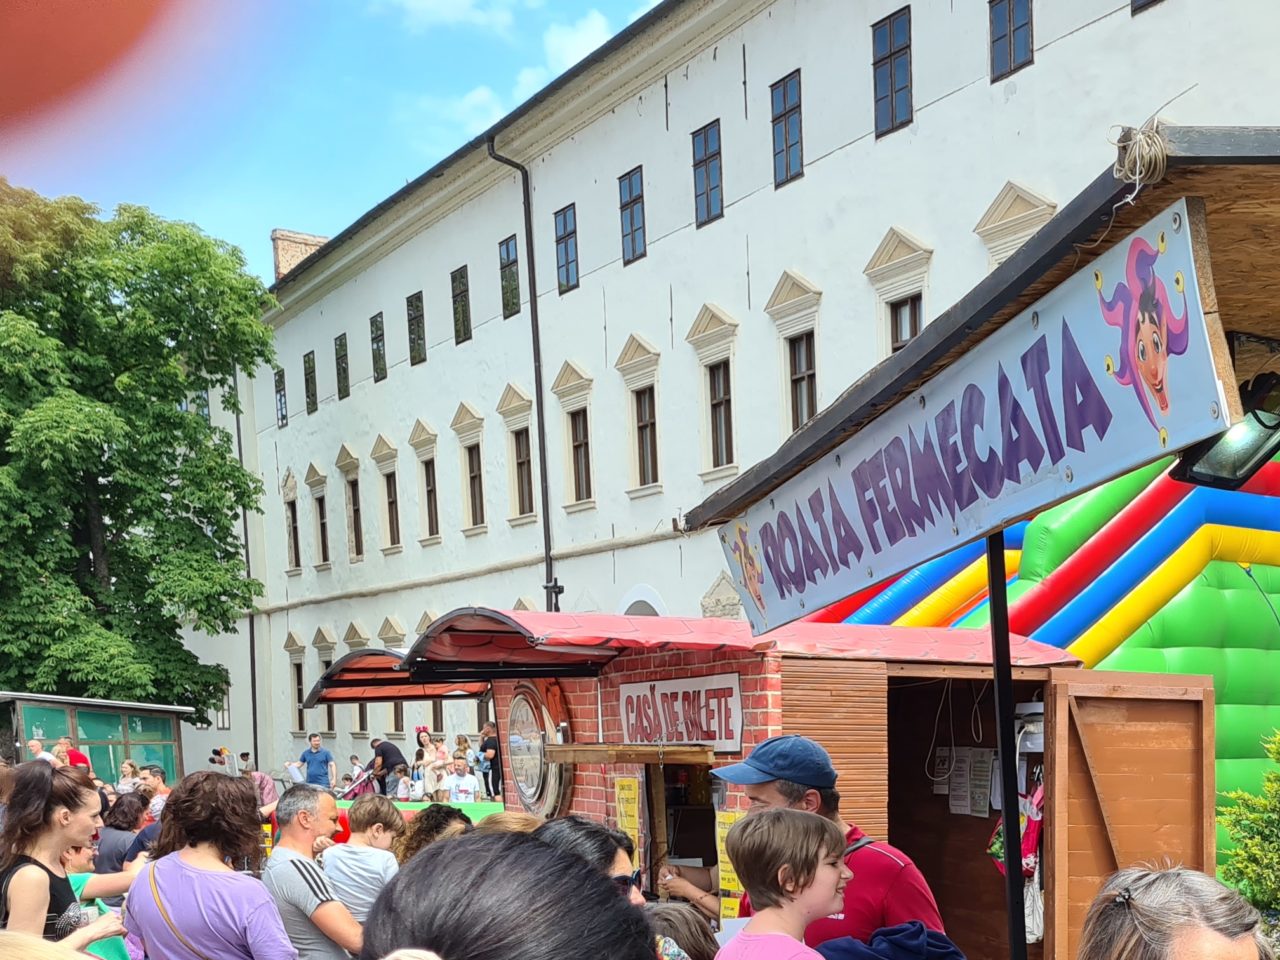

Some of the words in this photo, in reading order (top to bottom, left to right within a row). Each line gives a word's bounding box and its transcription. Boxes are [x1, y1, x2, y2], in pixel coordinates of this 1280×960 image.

[759, 477, 864, 601] ROATA
[852, 315, 1113, 556] FERMECATA
[660, 692, 684, 742] DE
[681, 687, 735, 741] BILETE
